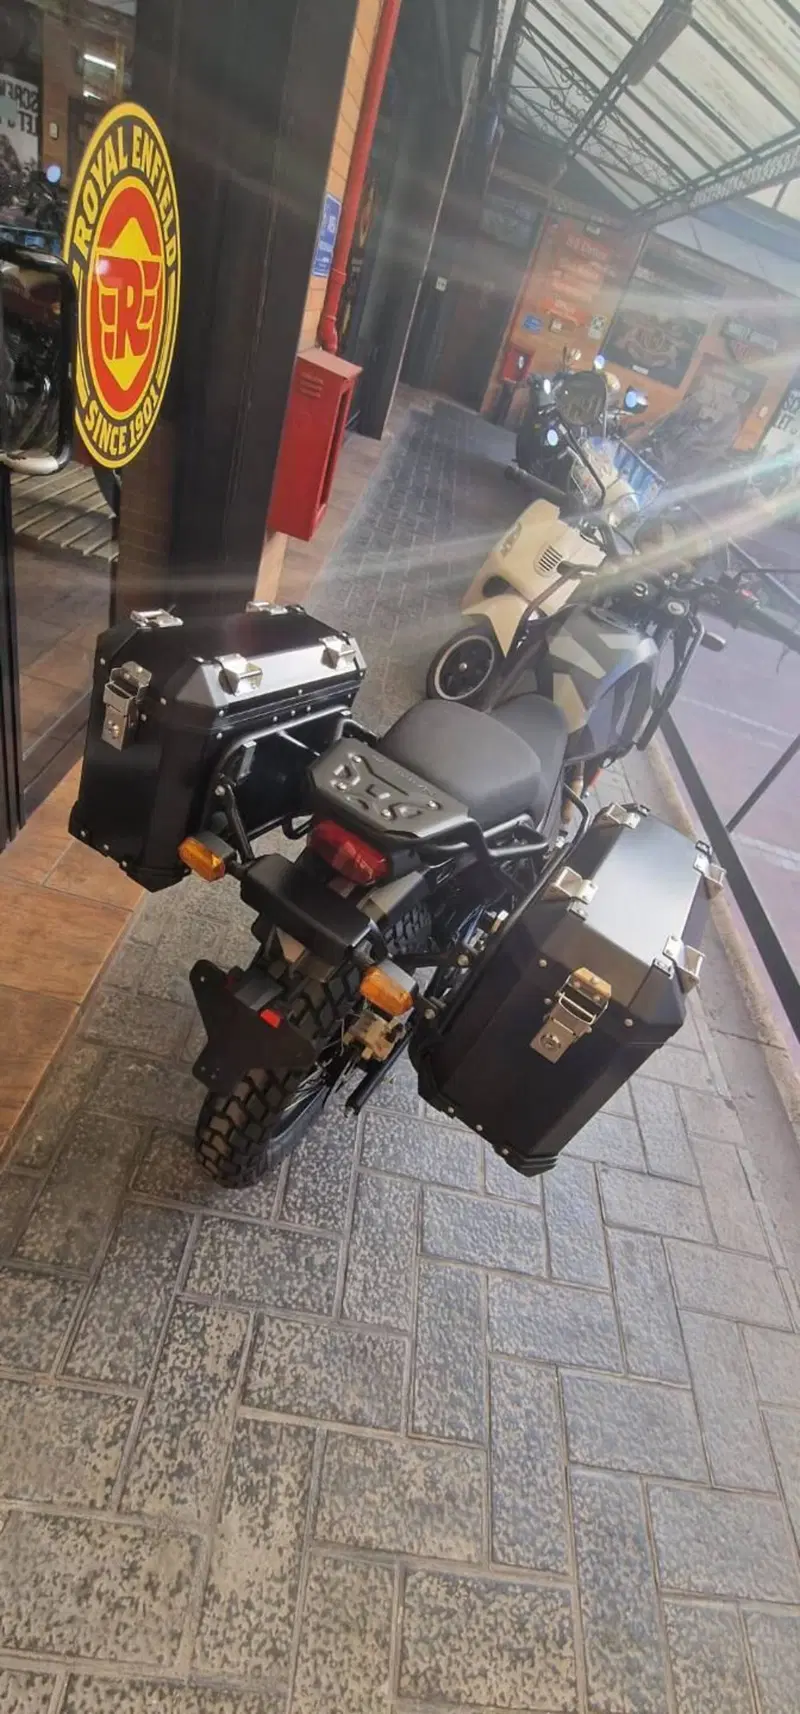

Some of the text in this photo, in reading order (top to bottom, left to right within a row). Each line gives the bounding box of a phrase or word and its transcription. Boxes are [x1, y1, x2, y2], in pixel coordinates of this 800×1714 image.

[74, 126, 128, 261] ROYAL
[132, 125, 176, 267] ENFIELD
[85, 383, 159, 455] SINCE 1901
